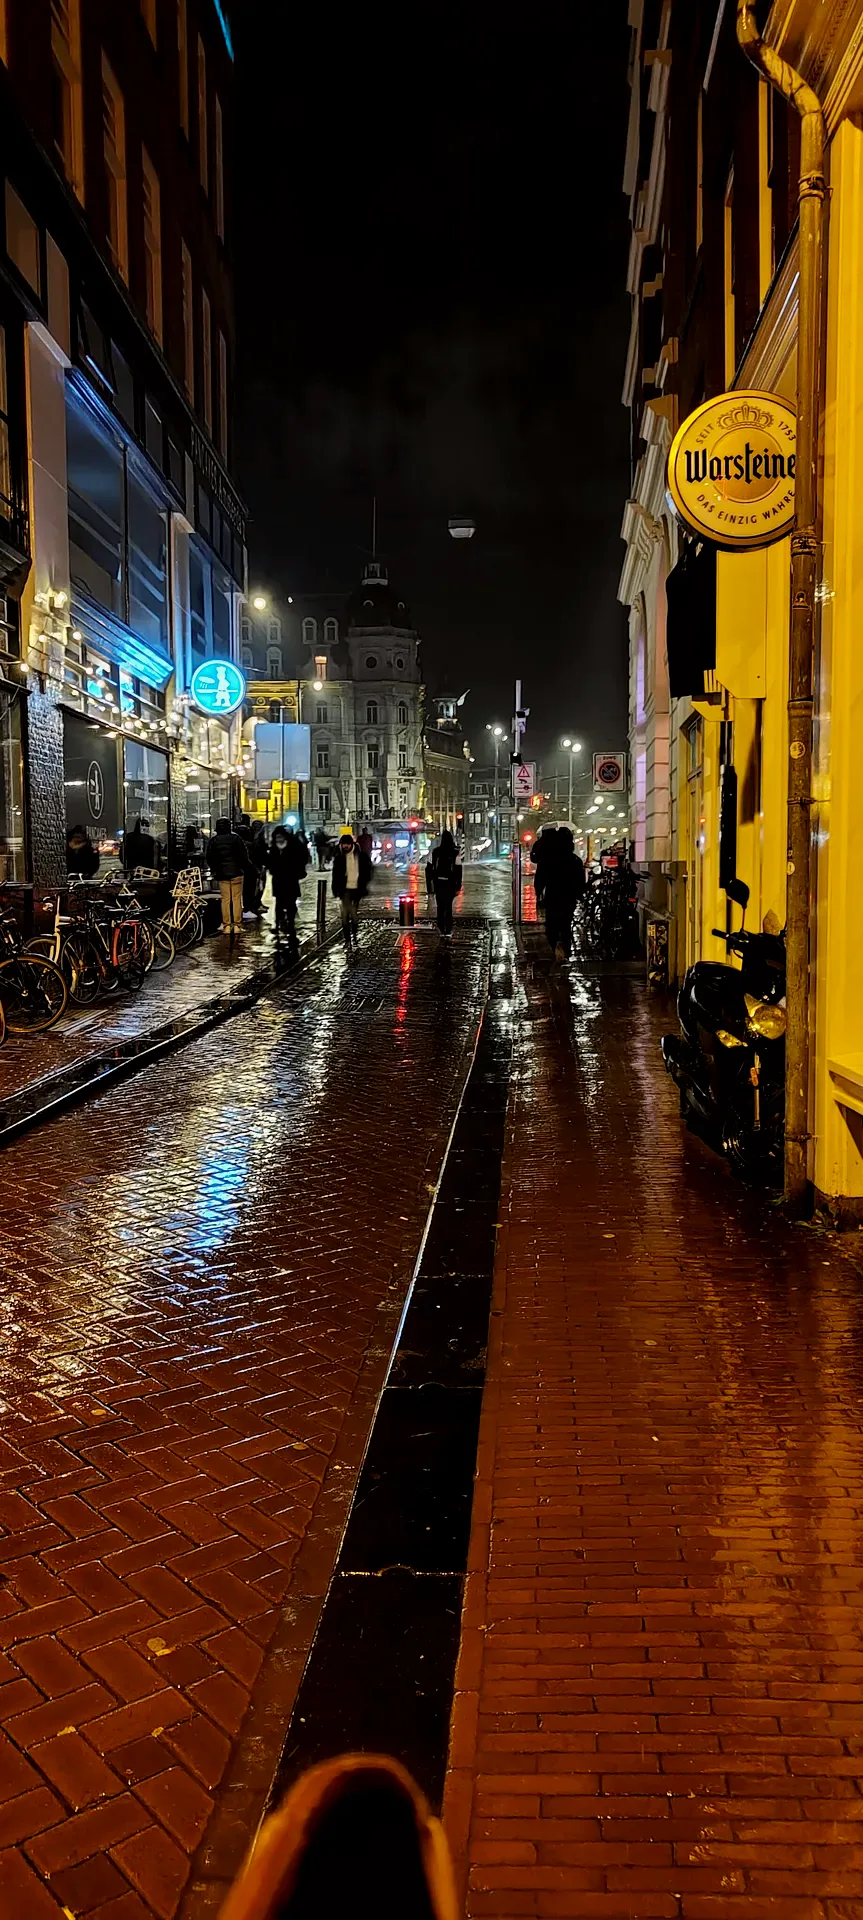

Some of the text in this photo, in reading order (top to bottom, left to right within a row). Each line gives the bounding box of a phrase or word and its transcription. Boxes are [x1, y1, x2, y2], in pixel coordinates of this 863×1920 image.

[696, 421, 797, 444] SEIT 1753
[684, 442, 796, 484] Warsteine
[696, 490, 796, 525] DAS EINZIG WAHRE
